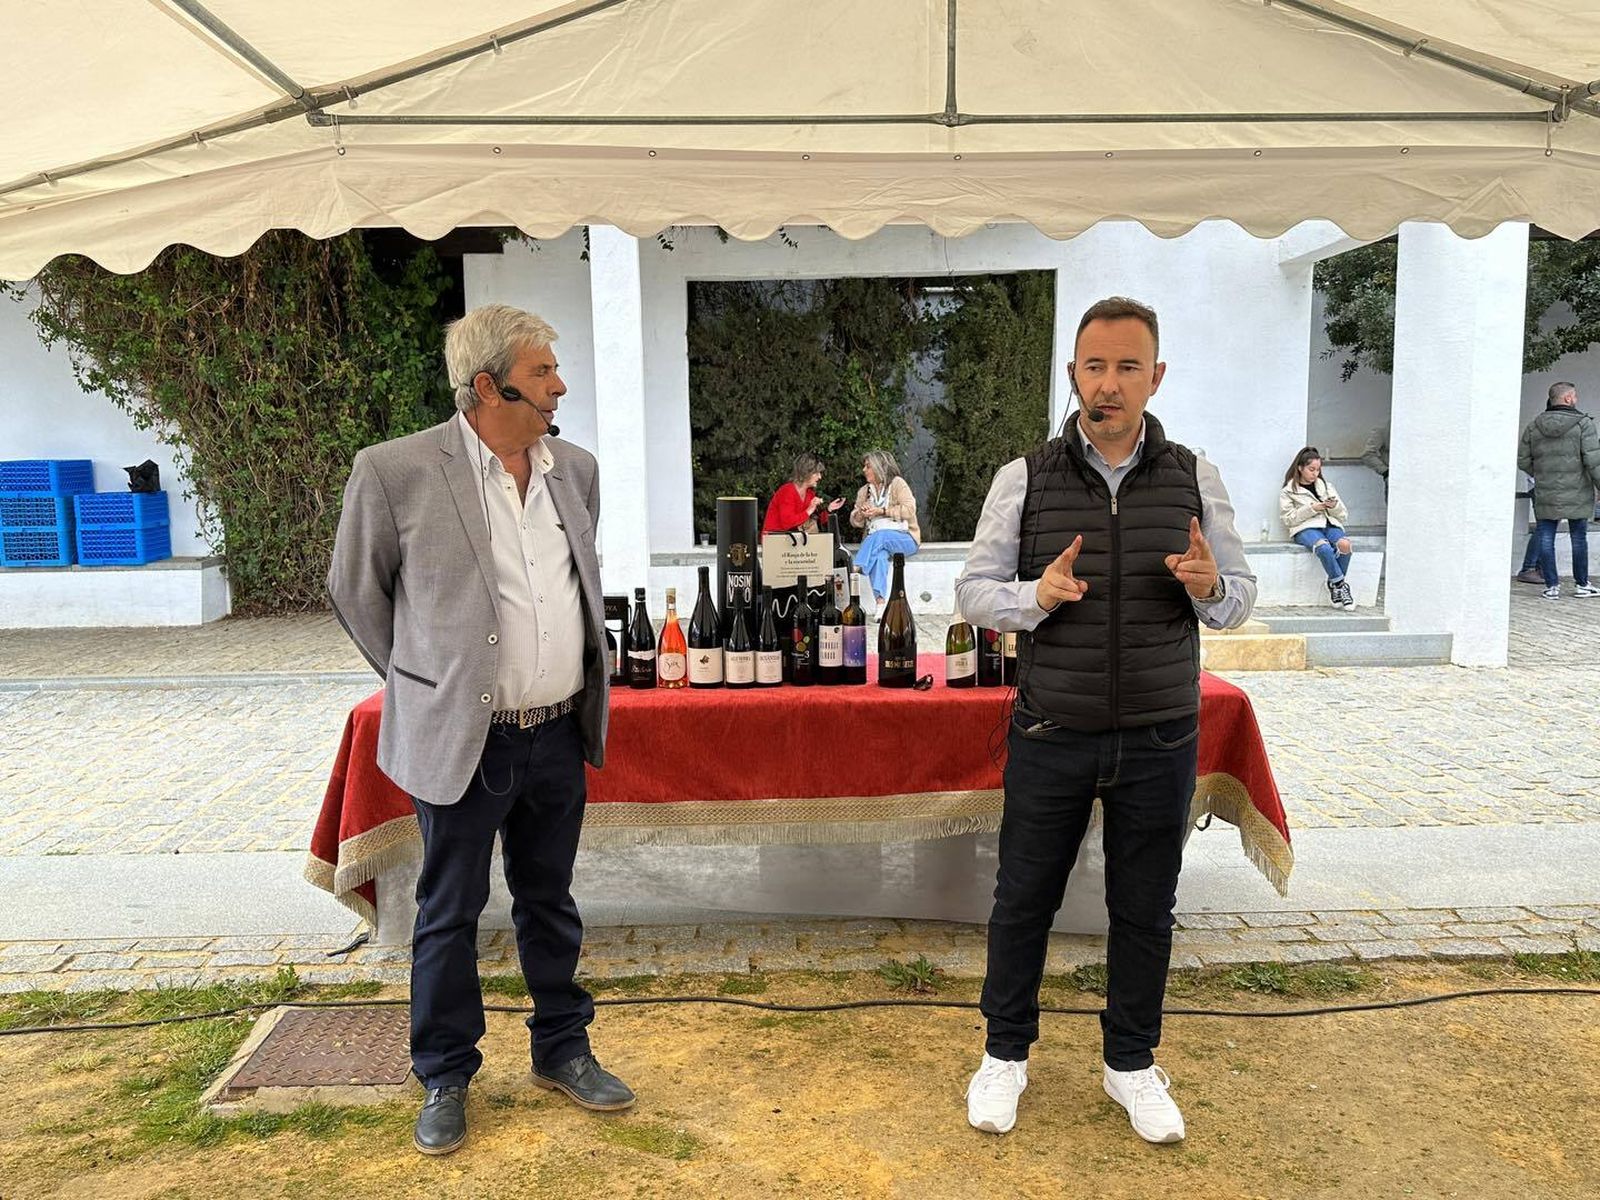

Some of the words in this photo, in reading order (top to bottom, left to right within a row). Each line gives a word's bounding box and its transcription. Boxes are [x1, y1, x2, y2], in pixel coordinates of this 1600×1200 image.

[728, 574, 751, 587] NOSIN
[728, 587, 751, 603] VO
[804, 650, 810, 659] 3
